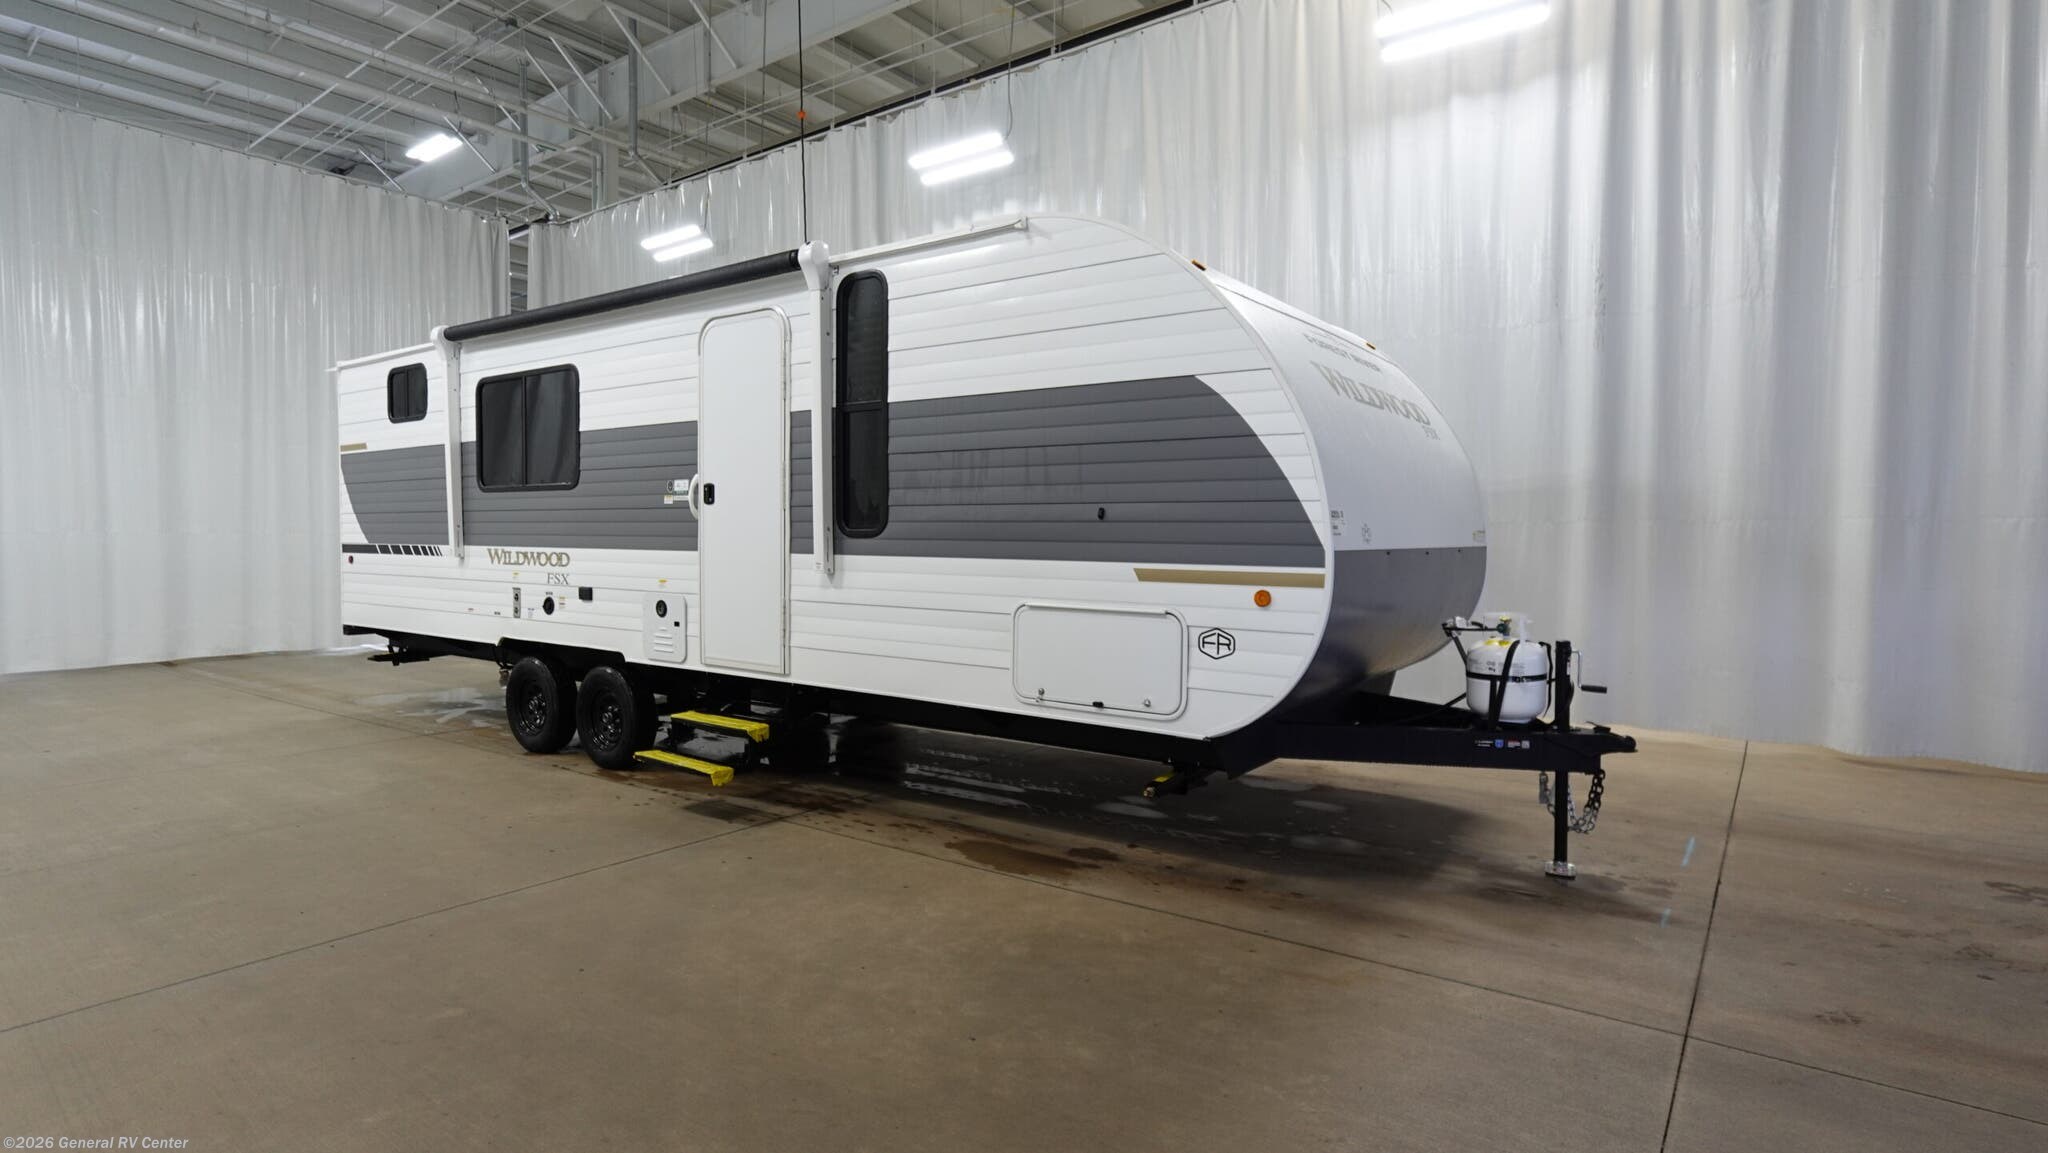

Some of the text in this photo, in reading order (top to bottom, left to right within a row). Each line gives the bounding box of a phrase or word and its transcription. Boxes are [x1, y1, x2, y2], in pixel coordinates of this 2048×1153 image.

[1310, 360, 1431, 426] WILDWOOD
[487, 548, 571, 567] WILDWOOD
[547, 572, 570, 585] FSX
